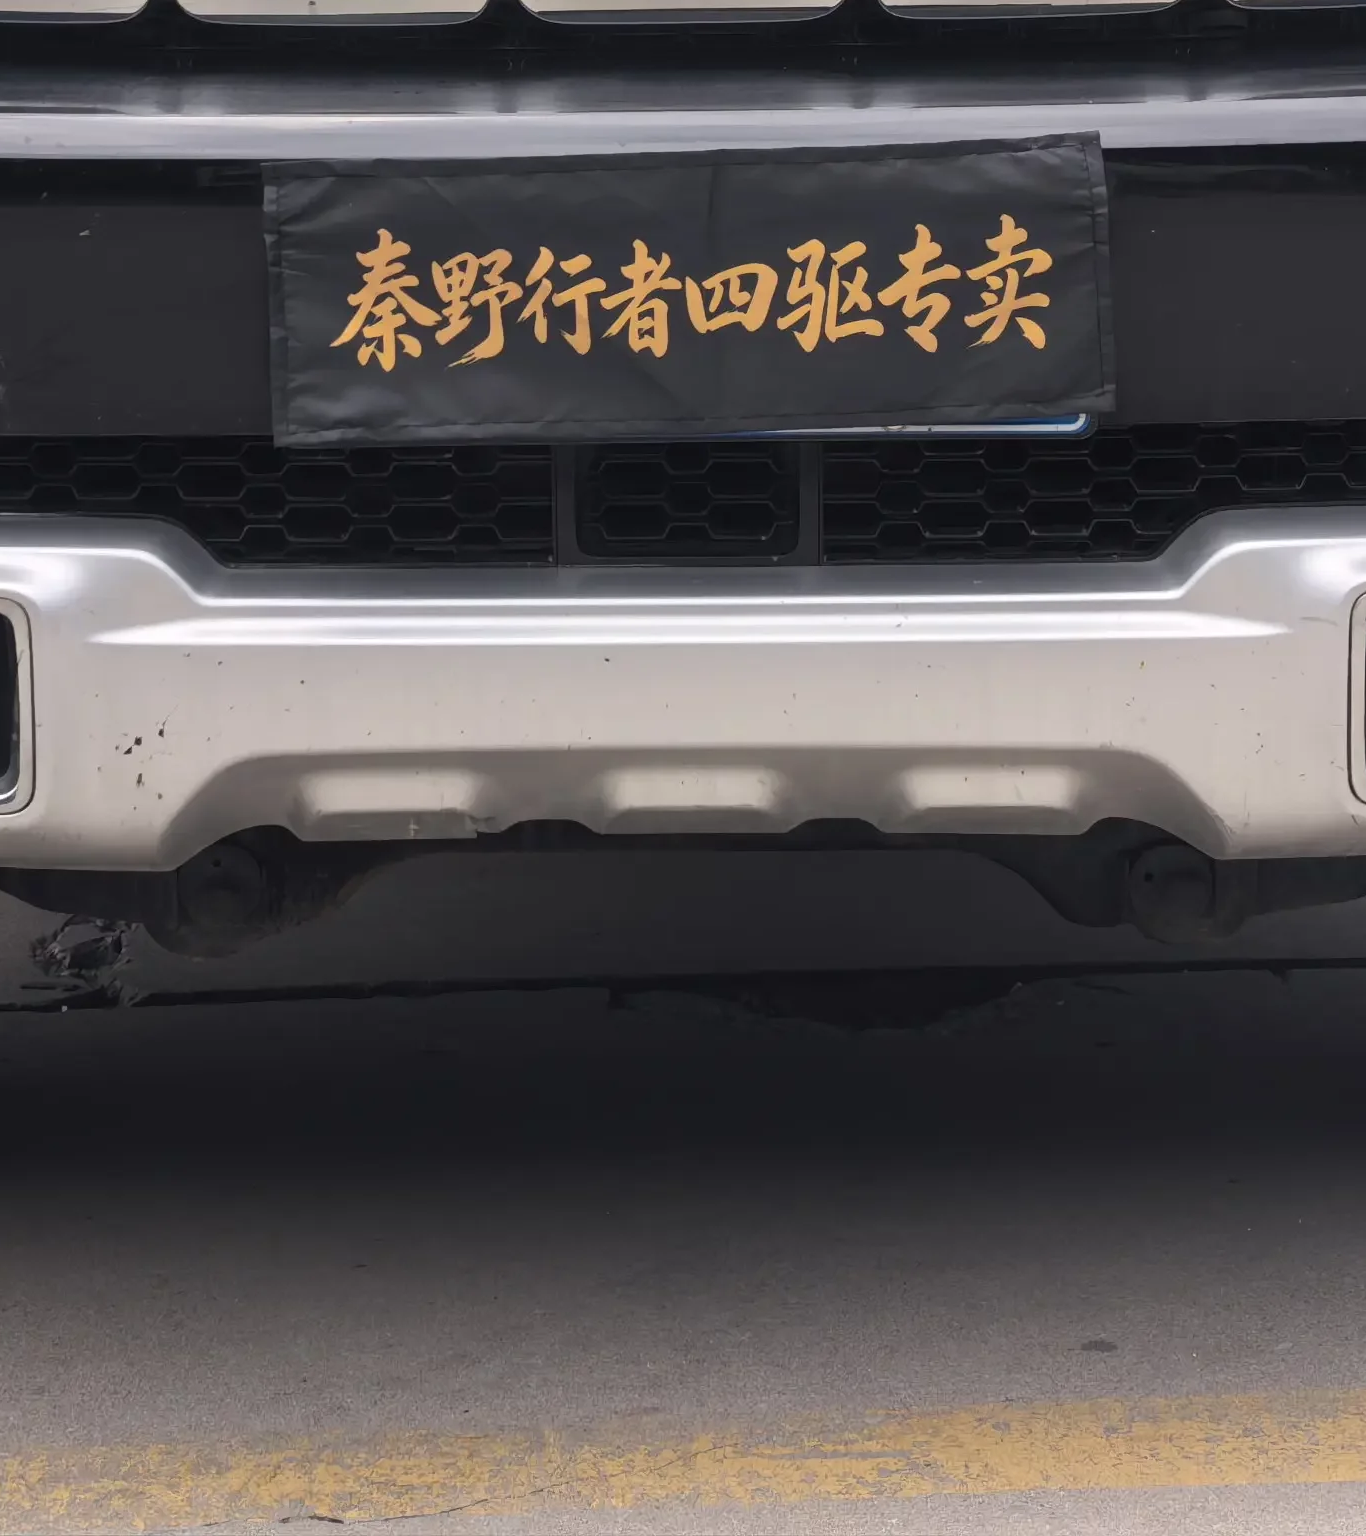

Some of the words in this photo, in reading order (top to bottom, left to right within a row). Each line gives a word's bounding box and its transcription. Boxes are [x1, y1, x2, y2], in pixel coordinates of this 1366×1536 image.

[332, 215, 1053, 371] 秦野行者四驱专卖
